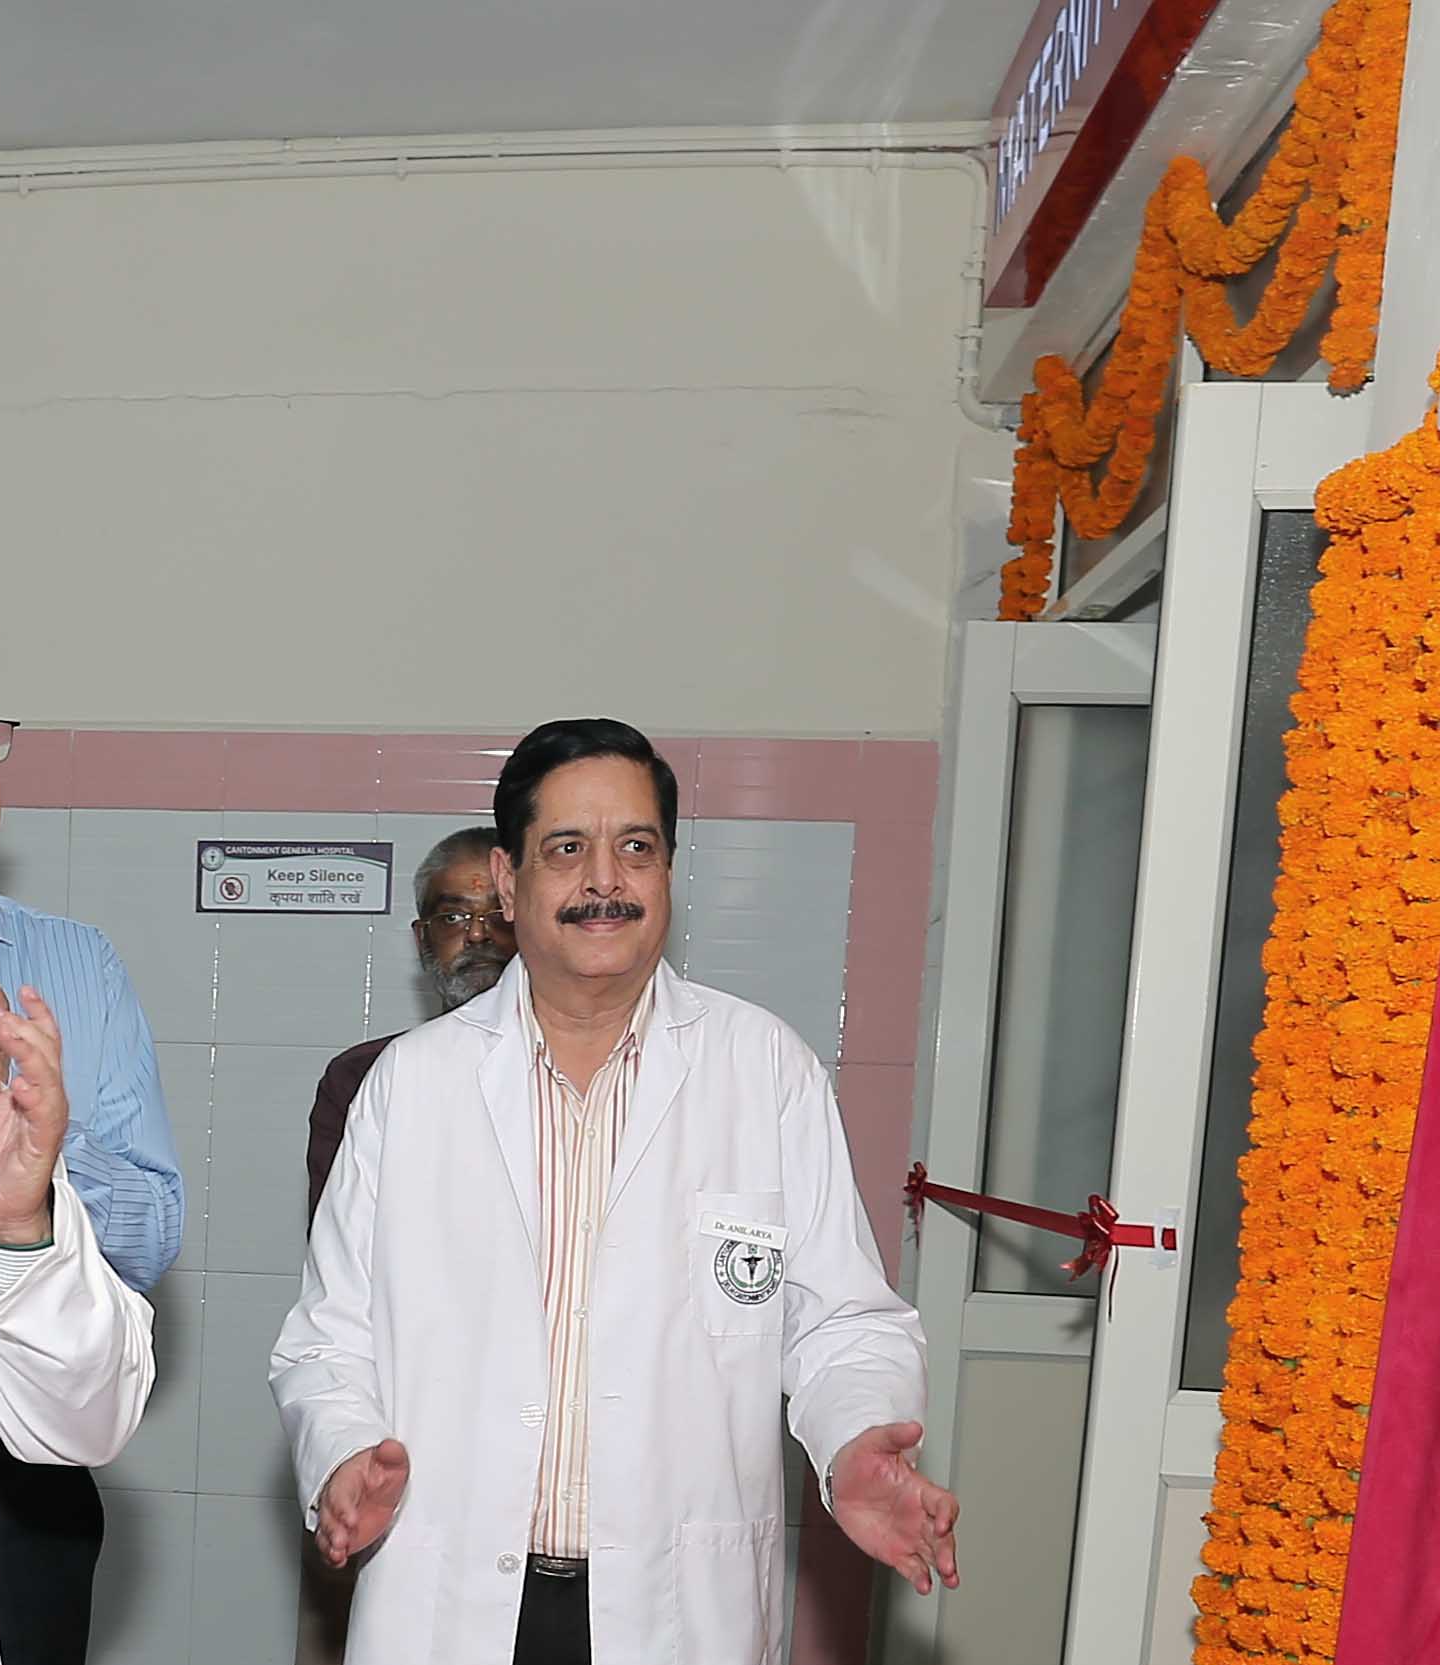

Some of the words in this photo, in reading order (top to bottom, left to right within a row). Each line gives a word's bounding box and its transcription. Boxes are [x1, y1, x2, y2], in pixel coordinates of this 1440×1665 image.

[225, 846, 280, 855] CANTONMENT
[281, 846, 317, 855] GENERAL
[267, 869, 305, 884] Keep
[309, 868, 365, 882] Silence
